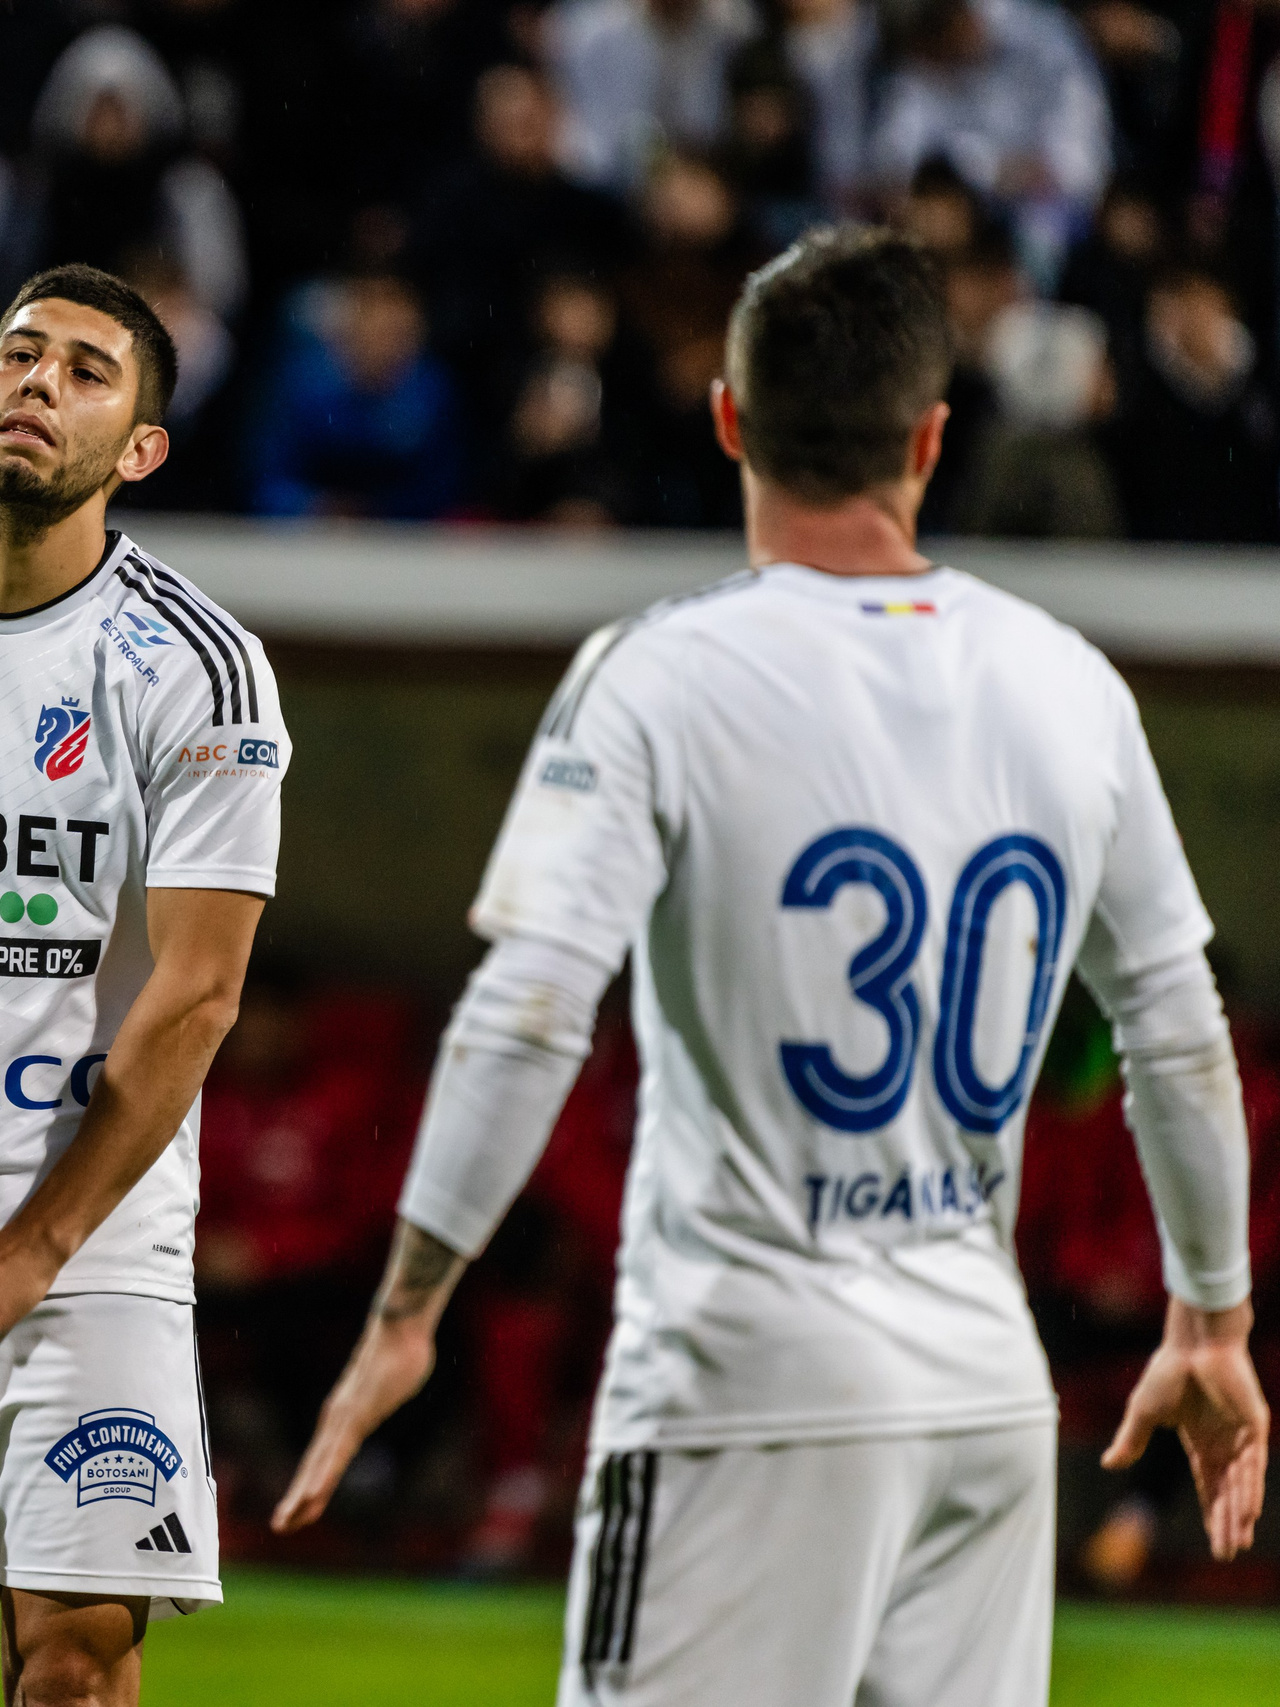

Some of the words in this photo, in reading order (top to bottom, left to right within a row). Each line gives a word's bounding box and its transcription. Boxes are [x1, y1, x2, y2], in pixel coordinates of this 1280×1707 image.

[45, 947, 84, 975] 0%
[780, 825, 1068, 1134] 30
[53, 1437, 87, 1471] FIVE
[87, 1425, 178, 1471] CONTINENTS
[87, 1468, 149, 1479] BOTOSANI
[103, 1486, 131, 1495] GROUP
